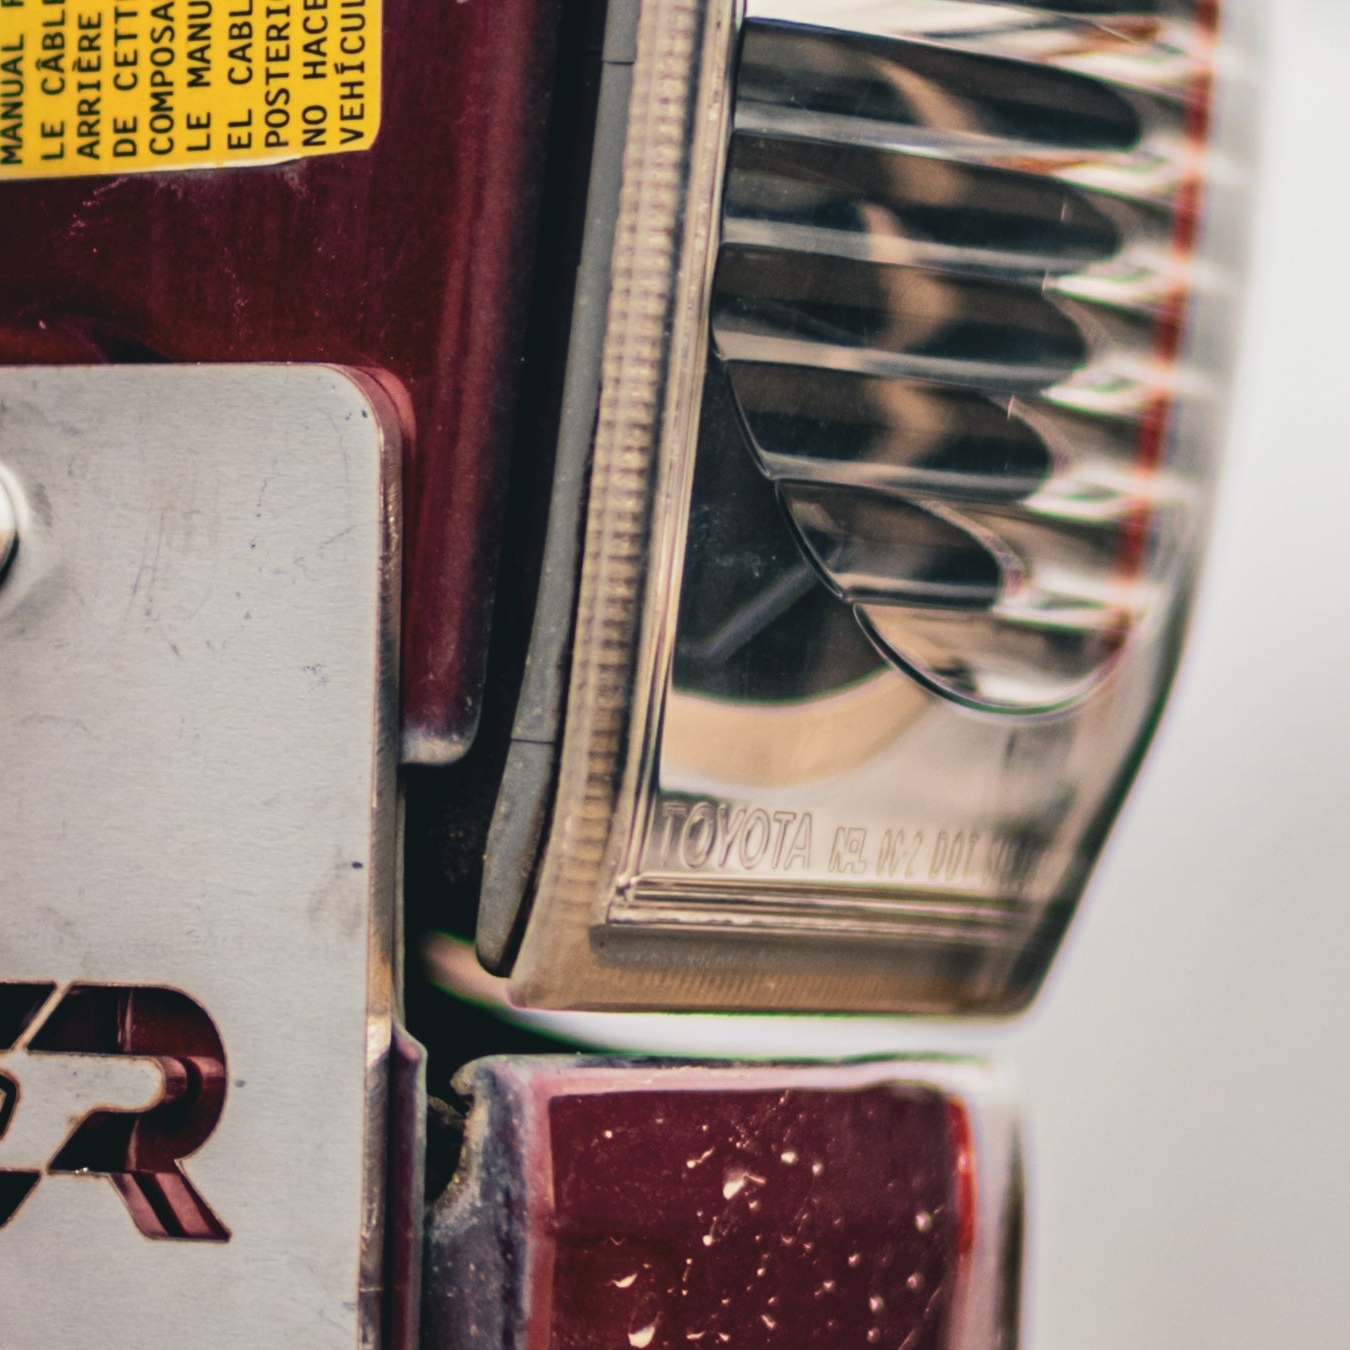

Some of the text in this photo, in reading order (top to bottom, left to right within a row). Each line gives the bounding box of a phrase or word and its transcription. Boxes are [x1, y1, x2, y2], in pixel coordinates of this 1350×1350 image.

[0, 34, 24, 165] MANUAL
[36, 0, 66, 160] LE CÂBL
[72, 12, 102, 160] ARRIÈRE
[113, 0, 139, 158] DE CETT
[149, 0, 175, 155] COMPOSA
[187, 0, 212, 151] LE MANU
[227, 0, 253, 150] EL CABL
[264, 0, 291, 148] POSTERI
[302, 105, 328, 147] NO
[659, 801, 813, 870] TOYOTA
